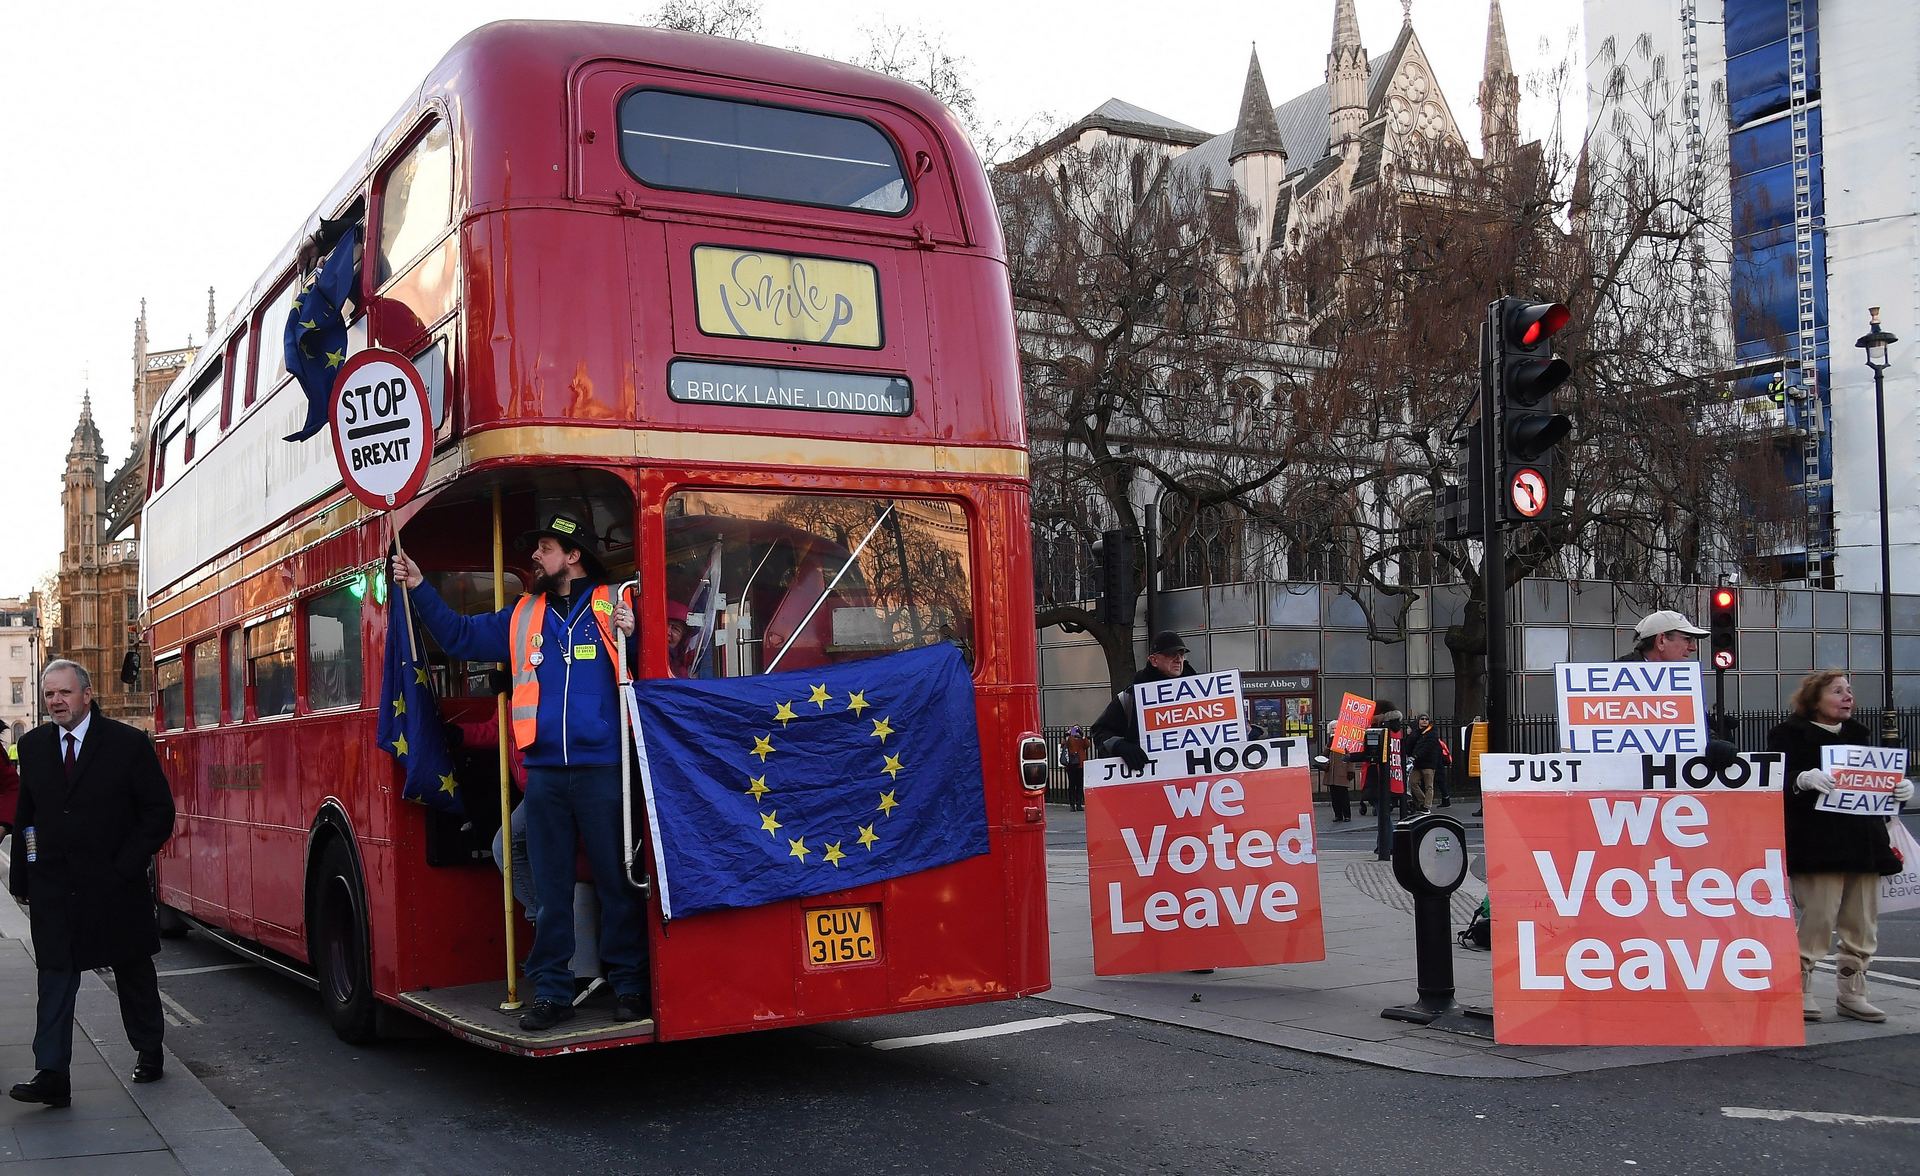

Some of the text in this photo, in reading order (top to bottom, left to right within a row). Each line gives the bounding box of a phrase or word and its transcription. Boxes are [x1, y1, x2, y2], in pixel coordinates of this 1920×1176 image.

[731, 254, 828, 326] Smile
[341, 377, 407, 425] STOP
[687, 380, 748, 403] BRICK
[351, 437, 411, 471] BREXIT
[1141, 673, 1234, 706] LEAVE
[1241, 679, 1297, 689] inster Abbey
[1565, 667, 1693, 693] LEAVE
[1155, 702, 1225, 726] MEANS
[1345, 699, 1372, 715] HOOT
[1583, 700, 1679, 720] MEANS
[1146, 722, 1240, 753] LEAVE
[1336, 737, 1364, 752] BREXIT
[1340, 725, 1366, 740] IS NOT
[1569, 728, 1698, 754] LEAVE
[1186, 740, 1295, 775] HOOT
[1829, 748, 1904, 770] LEAVE
[1508, 754, 1782, 790] JUST HOOT
[1838, 772, 1896, 790] MEANS
[1163, 778, 1245, 819] we
[1822, 792, 1896, 812] LEAVE
[1589, 794, 1710, 847] we
[1120, 814, 1317, 877] Voted
[1533, 849, 1791, 918] Voted
[1882, 884, 1920, 898] Leave
[1886, 872, 1917, 885] Vote
[1108, 880, 1299, 935] Leave
[817, 911, 862, 936] CUV
[811, 936, 872, 963] 315C
[1517, 920, 1773, 991] Leave
